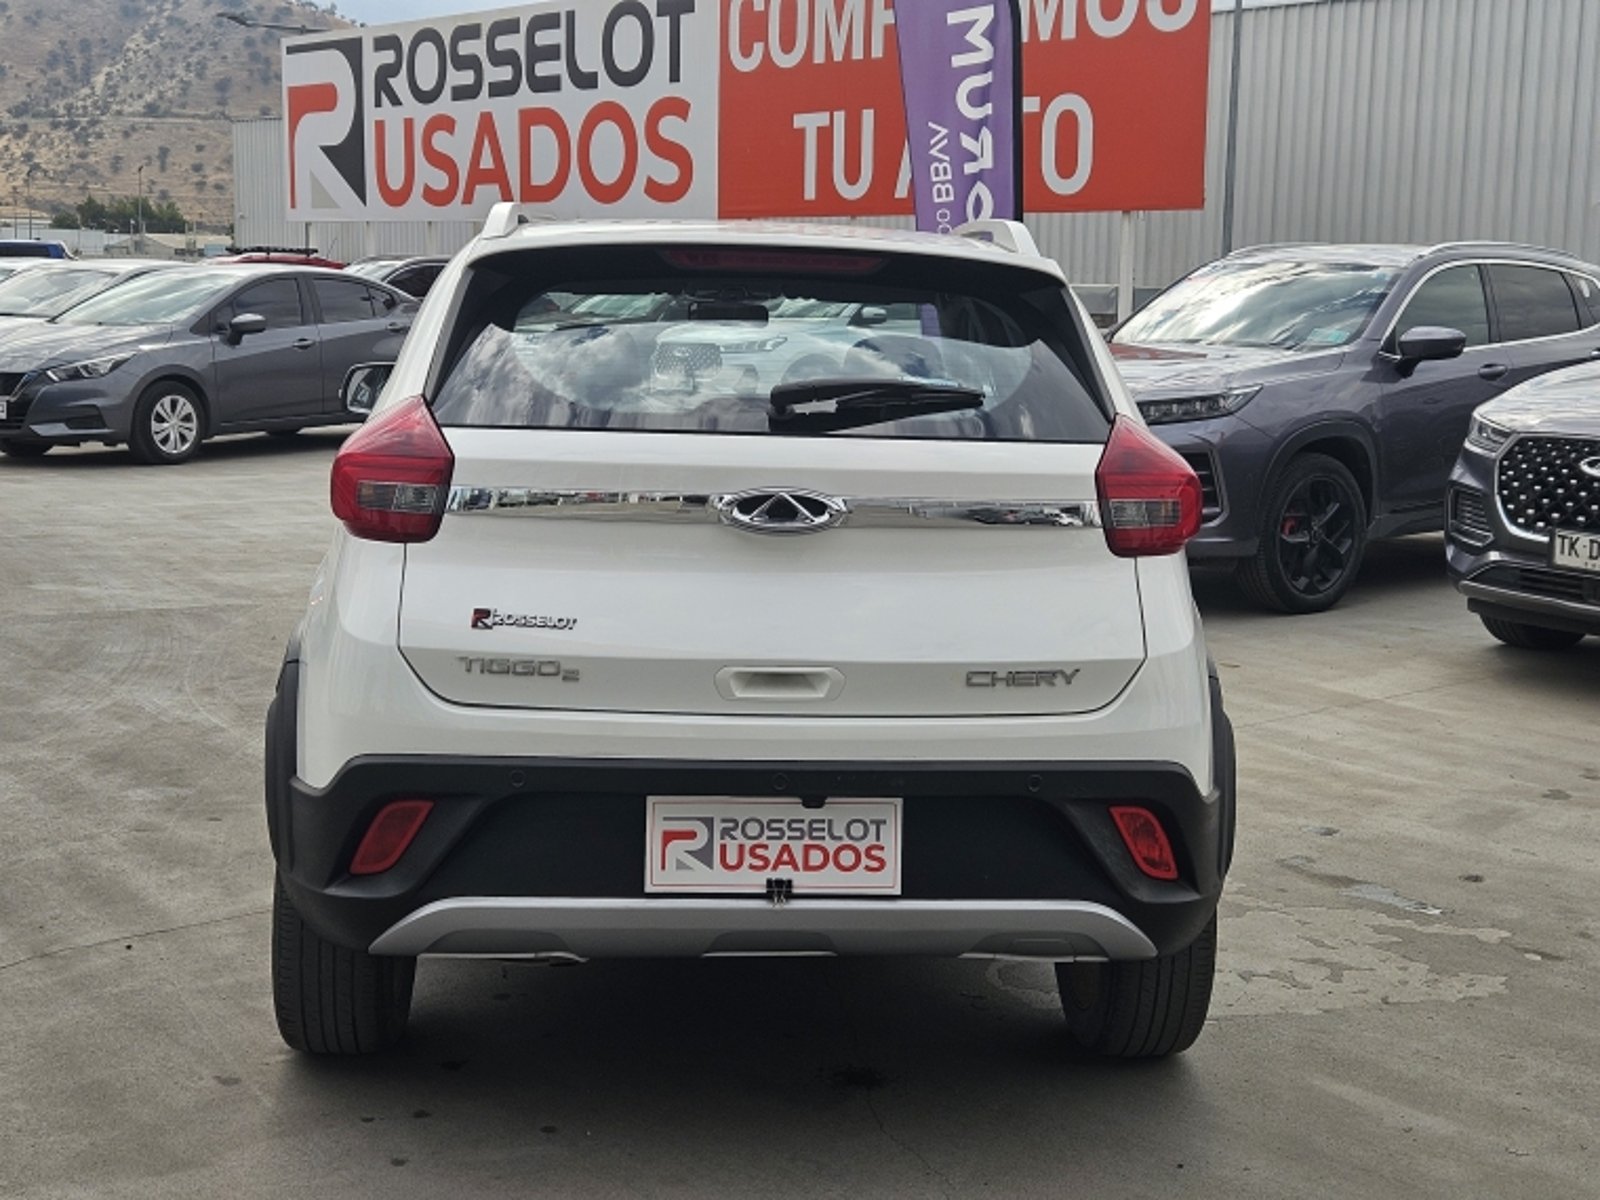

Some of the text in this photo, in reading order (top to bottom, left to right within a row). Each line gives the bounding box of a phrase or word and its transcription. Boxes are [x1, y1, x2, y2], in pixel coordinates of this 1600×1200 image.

[373, 0, 695, 108] ROSSELOT
[374, 96, 694, 207] USADOS
[793, 109, 874, 200] TU
[966, 668, 1080, 687] CHERY
[719, 817, 887, 842] ROSSELOT
[719, 843, 887, 873] USADOS
